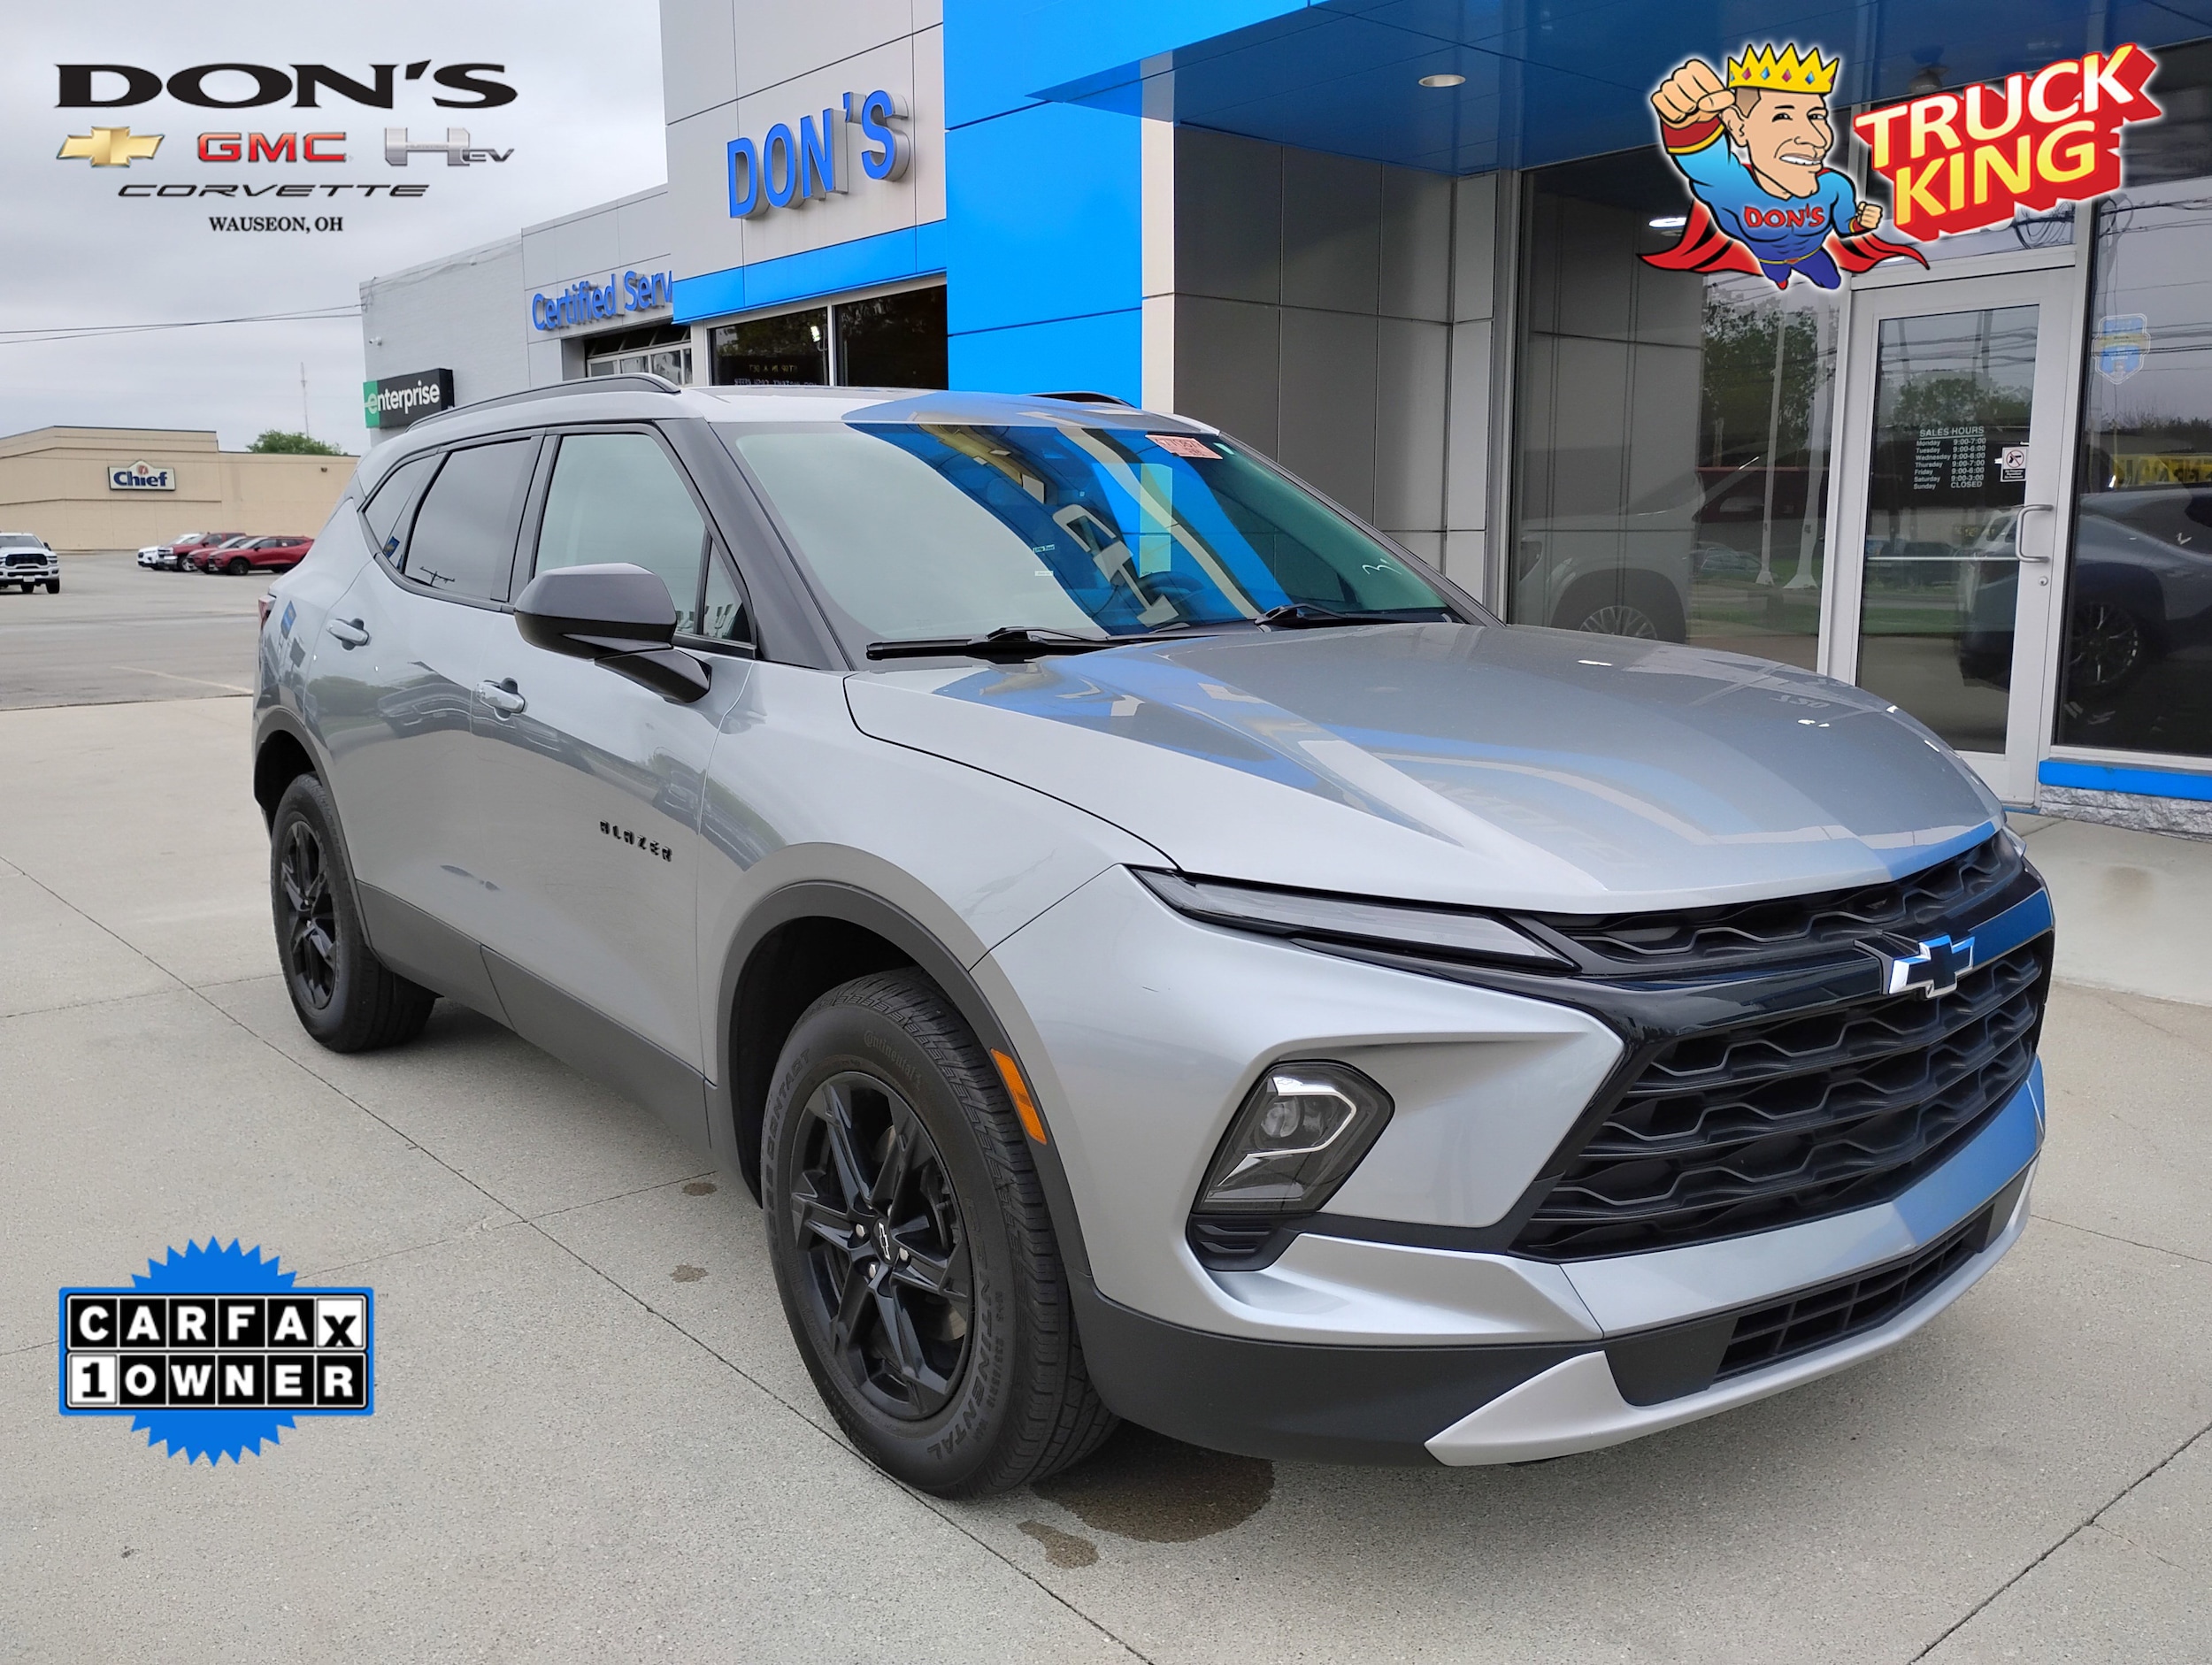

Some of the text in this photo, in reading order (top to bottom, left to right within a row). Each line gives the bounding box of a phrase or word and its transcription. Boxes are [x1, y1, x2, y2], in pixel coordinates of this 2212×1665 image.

[726, 89, 908, 219] DON'S
[532, 270, 673, 331] Certified Serv
[364, 380, 441, 414] enterprise
[1919, 426, 1985, 438] SALES HOURS
[113, 471, 168, 487] Chief
[1950, 480, 1983, 489] CLOSED
[600, 820, 672, 863] BLAZER
